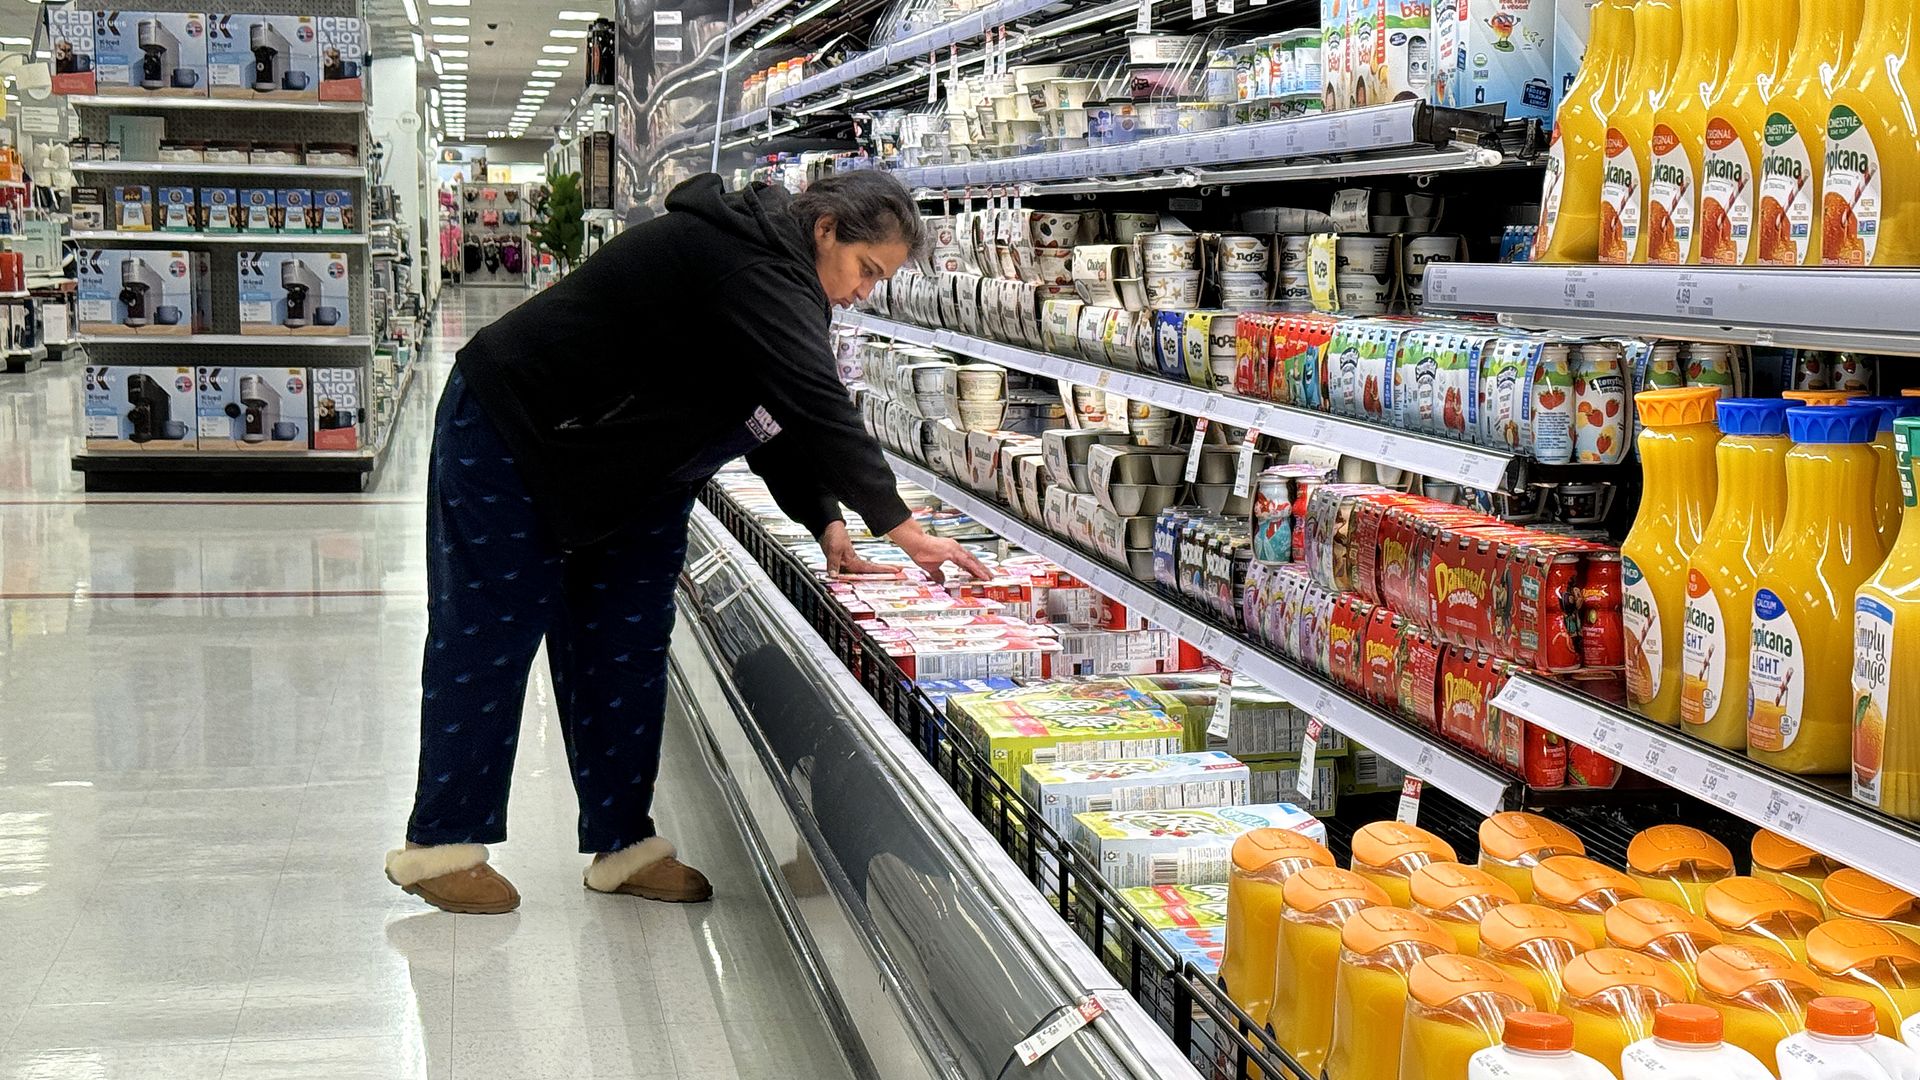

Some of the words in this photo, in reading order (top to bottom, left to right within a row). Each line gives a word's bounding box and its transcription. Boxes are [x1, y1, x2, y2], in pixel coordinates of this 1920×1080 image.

[1401, 2, 1431, 18] bab
[49, 11, 91, 25] ICED
[318, 17, 361, 32] ICED
[62, 26, 92, 37] HOT
[328, 33, 361, 44] HOT
[1236, 251, 1264, 263] noosa
[312, 368, 356, 383] ICED
[324, 382, 356, 394] HOT
[1434, 557, 1488, 603] Danimals
[1752, 652, 1780, 675] LIGHT
[1444, 668, 1483, 714] Danimals
